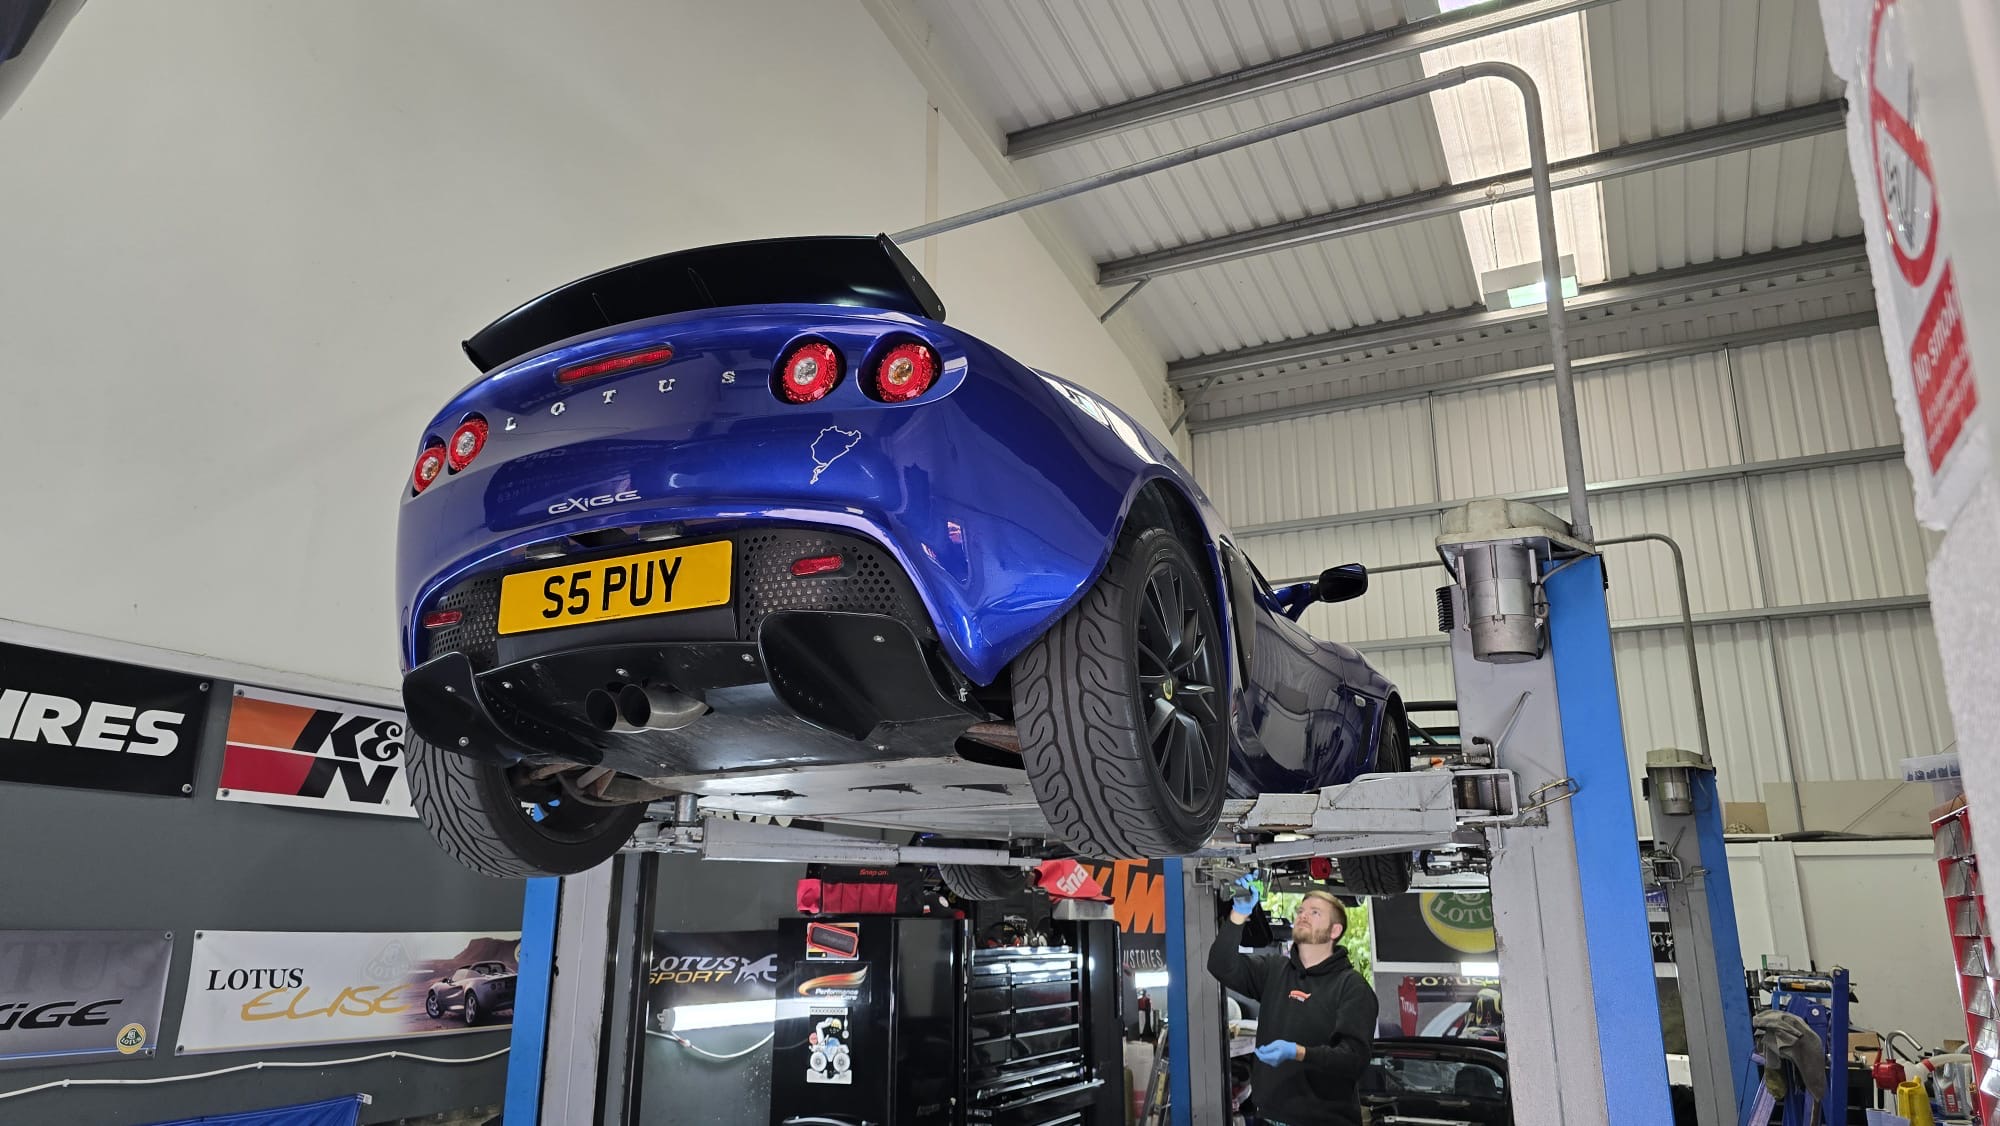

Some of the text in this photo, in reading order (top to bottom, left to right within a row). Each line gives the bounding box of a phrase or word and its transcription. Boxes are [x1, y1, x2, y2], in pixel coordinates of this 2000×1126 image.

[504, 370, 736, 431] LOTUS
[542, 556, 682, 619] S5 PUY
[0, 689, 185, 757] IRES
[1056, 863, 1089, 895] Sna
[1432, 899, 1492, 924] LOTU
[650, 956, 740, 972] LOTUS
[1122, 949, 1164, 969] USTRIES
[206, 968, 304, 991] LOTUS
[649, 970, 733, 985] SPORT
[240, 984, 412, 1021] ELISE
